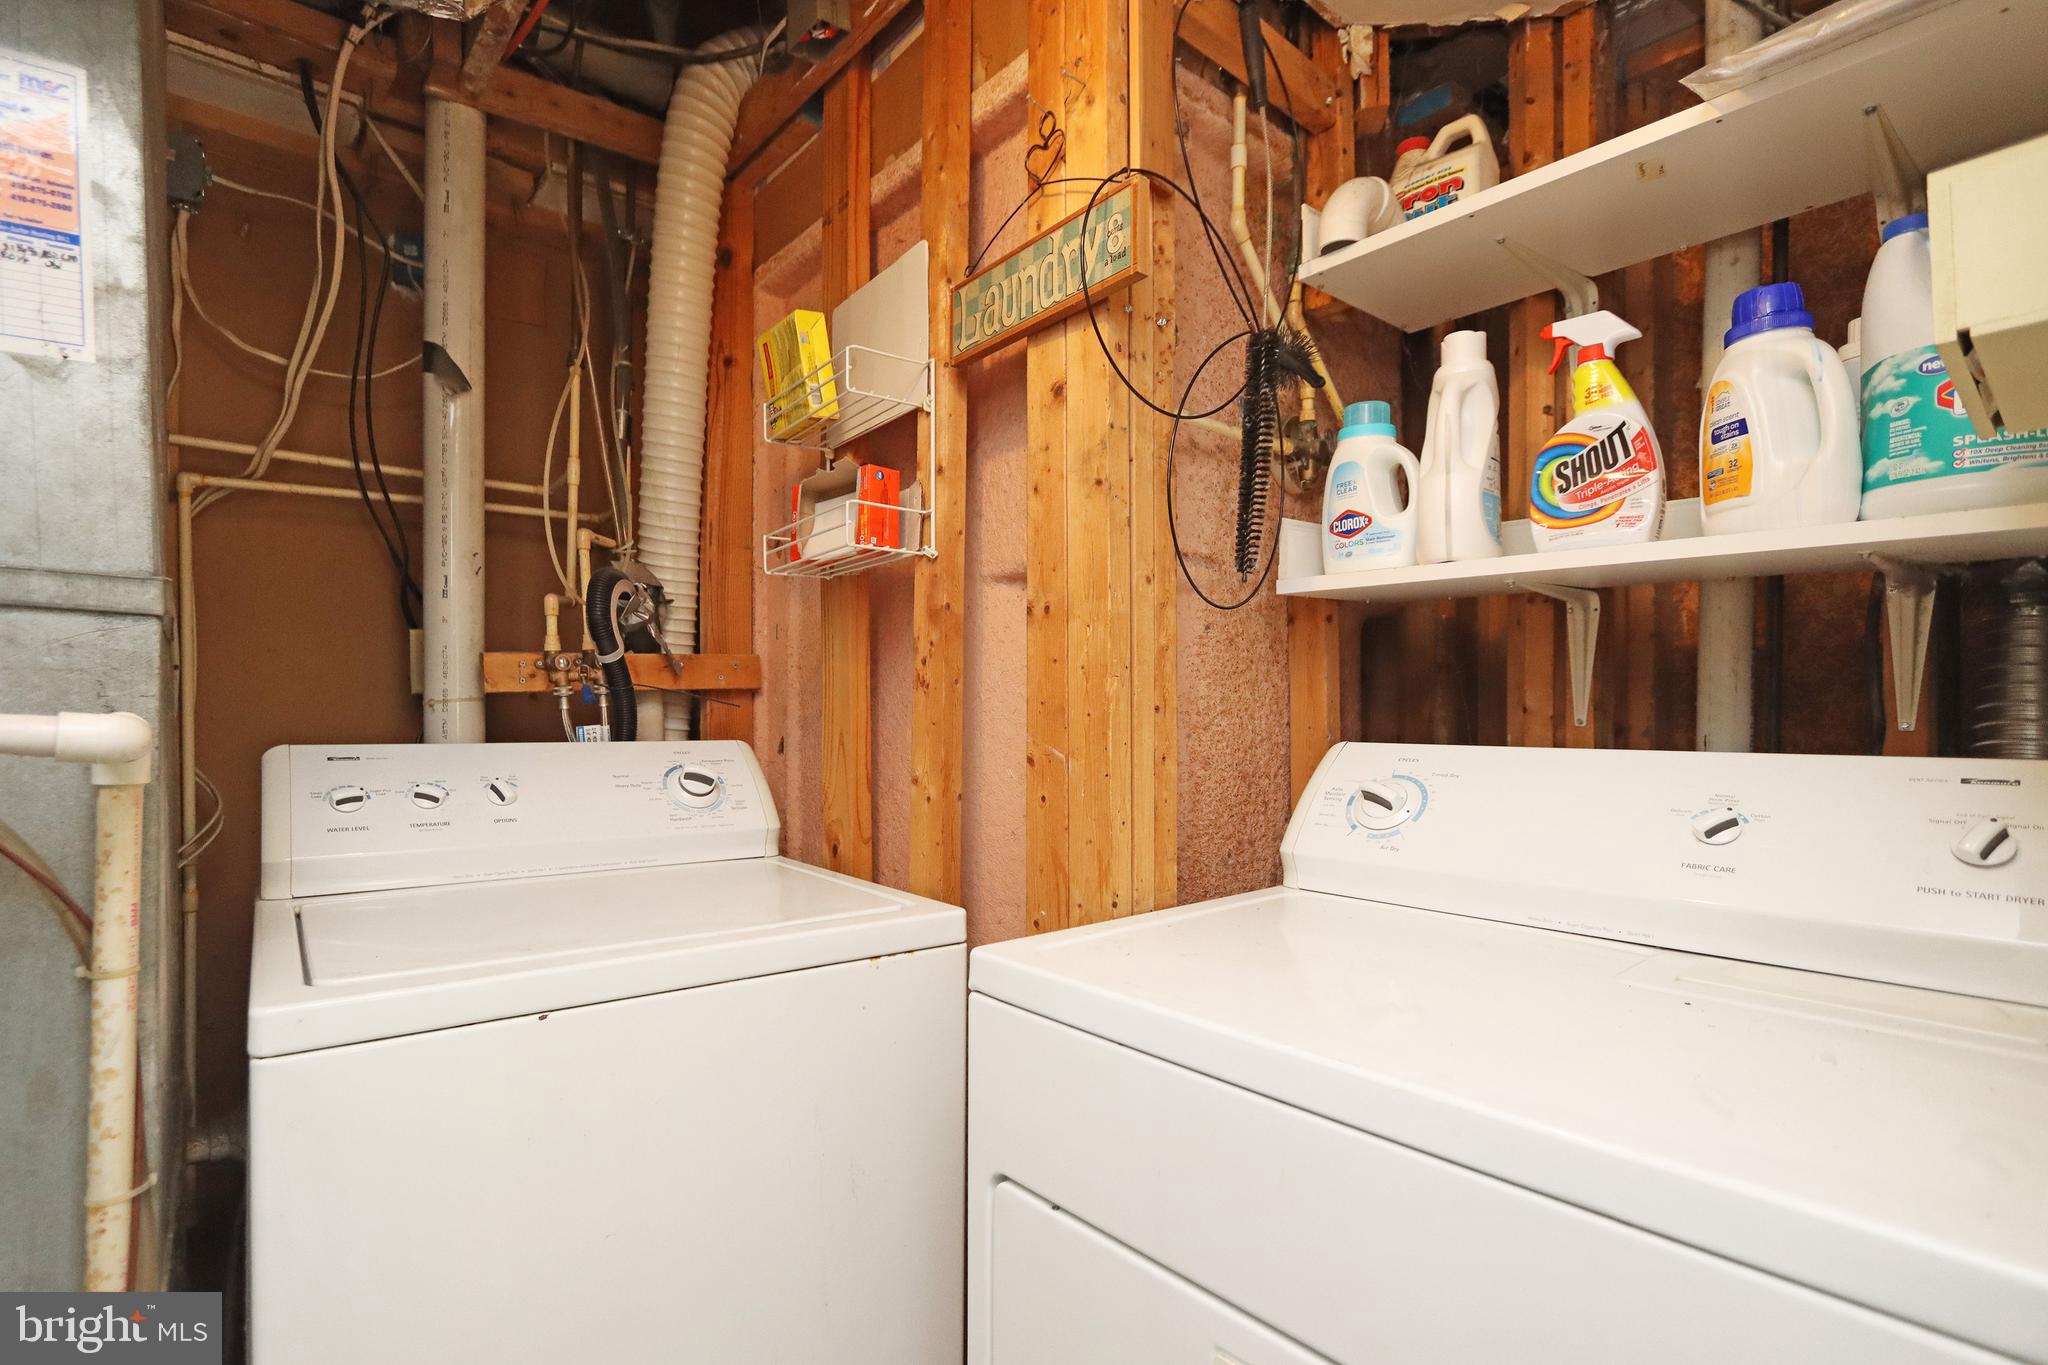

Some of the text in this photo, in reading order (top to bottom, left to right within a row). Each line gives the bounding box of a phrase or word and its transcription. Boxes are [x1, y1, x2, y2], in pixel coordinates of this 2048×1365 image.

[1104, 246, 1127, 267] a load
[956, 210, 1105, 352] Laundry
[1713, 422, 1740, 436] tough on
[1720, 429, 1740, 440] stains
[2005, 442, 2037, 452] Cleaning
[1556, 420, 1632, 495] SHOUT
[1336, 479, 1352, 489] FREE
[1336, 486, 1358, 496] CLEAR
[1335, 539, 1365, 550] COLORS
[409, 821, 451, 829] TEMPERATURE
[1928, 817, 1951, 825] Signal
[2004, 822, 2031, 831] Signal
[1681, 862, 1737, 874] FABRIC CARE
[1916, 885, 2046, 907] PUSH to START DRYER
